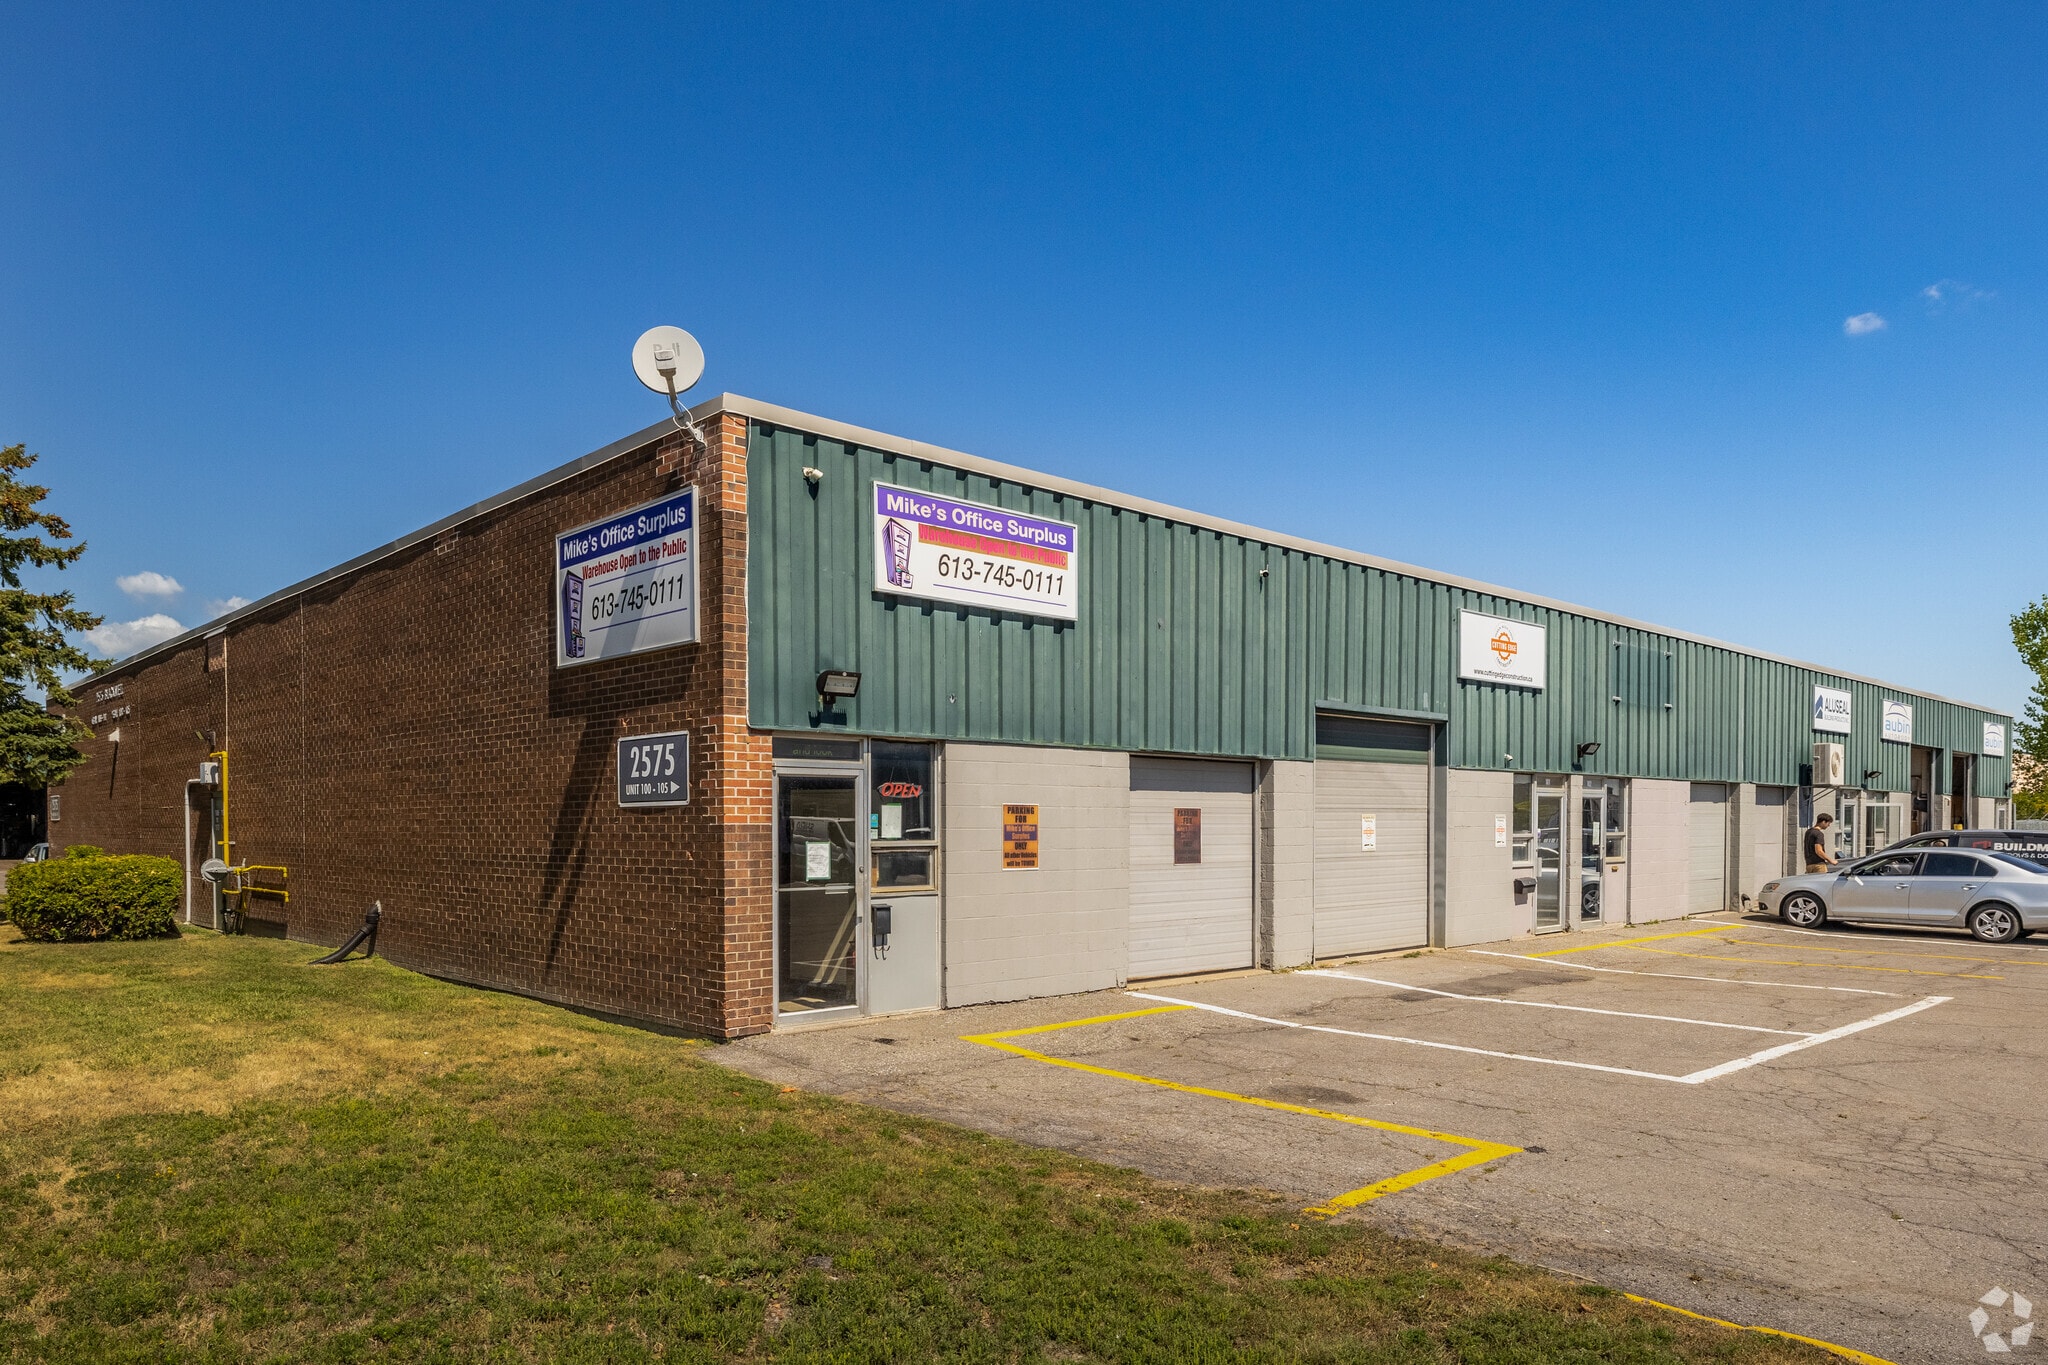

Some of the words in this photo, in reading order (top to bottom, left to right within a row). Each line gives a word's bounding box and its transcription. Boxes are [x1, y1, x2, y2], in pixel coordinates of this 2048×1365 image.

[886, 493, 947, 521] Mike's
[952, 508, 1003, 532] Office
[1007, 519, 1067, 546] Surplus
[563, 534, 598, 561] Mike's
[600, 524, 635, 548] Office
[637, 506, 686, 534] Surplus
[919, 524, 977, 549] Warehouse
[979, 536, 1005, 554] Open
[1007, 542, 1017, 557] to
[1019, 544, 1035, 560] the
[1037, 548, 1067, 567] Public
[582, 560, 618, 581] Warehouse
[619, 552, 637, 573] Open
[639, 551, 647, 564] to
[648, 545, 660, 561] the
[662, 538, 687, 559] Public
[938, 554, 1064, 596] 613-745-0111
[592, 574, 684, 620] 613-745-0111
[1825, 697, 1850, 715] ALUSEAL
[1885, 718, 1910, 734] aubin
[630, 743, 675, 778] 2575
[625, 784, 640, 796] UNIT
[641, 783, 652, 795] 100
[657, 782, 669, 794] 105
[881, 782, 922, 798] OPEN
[1007, 806, 1035, 814] PARKING
[1015, 815, 1027, 823] FOR
[1014, 842, 1027, 850] ONLY
